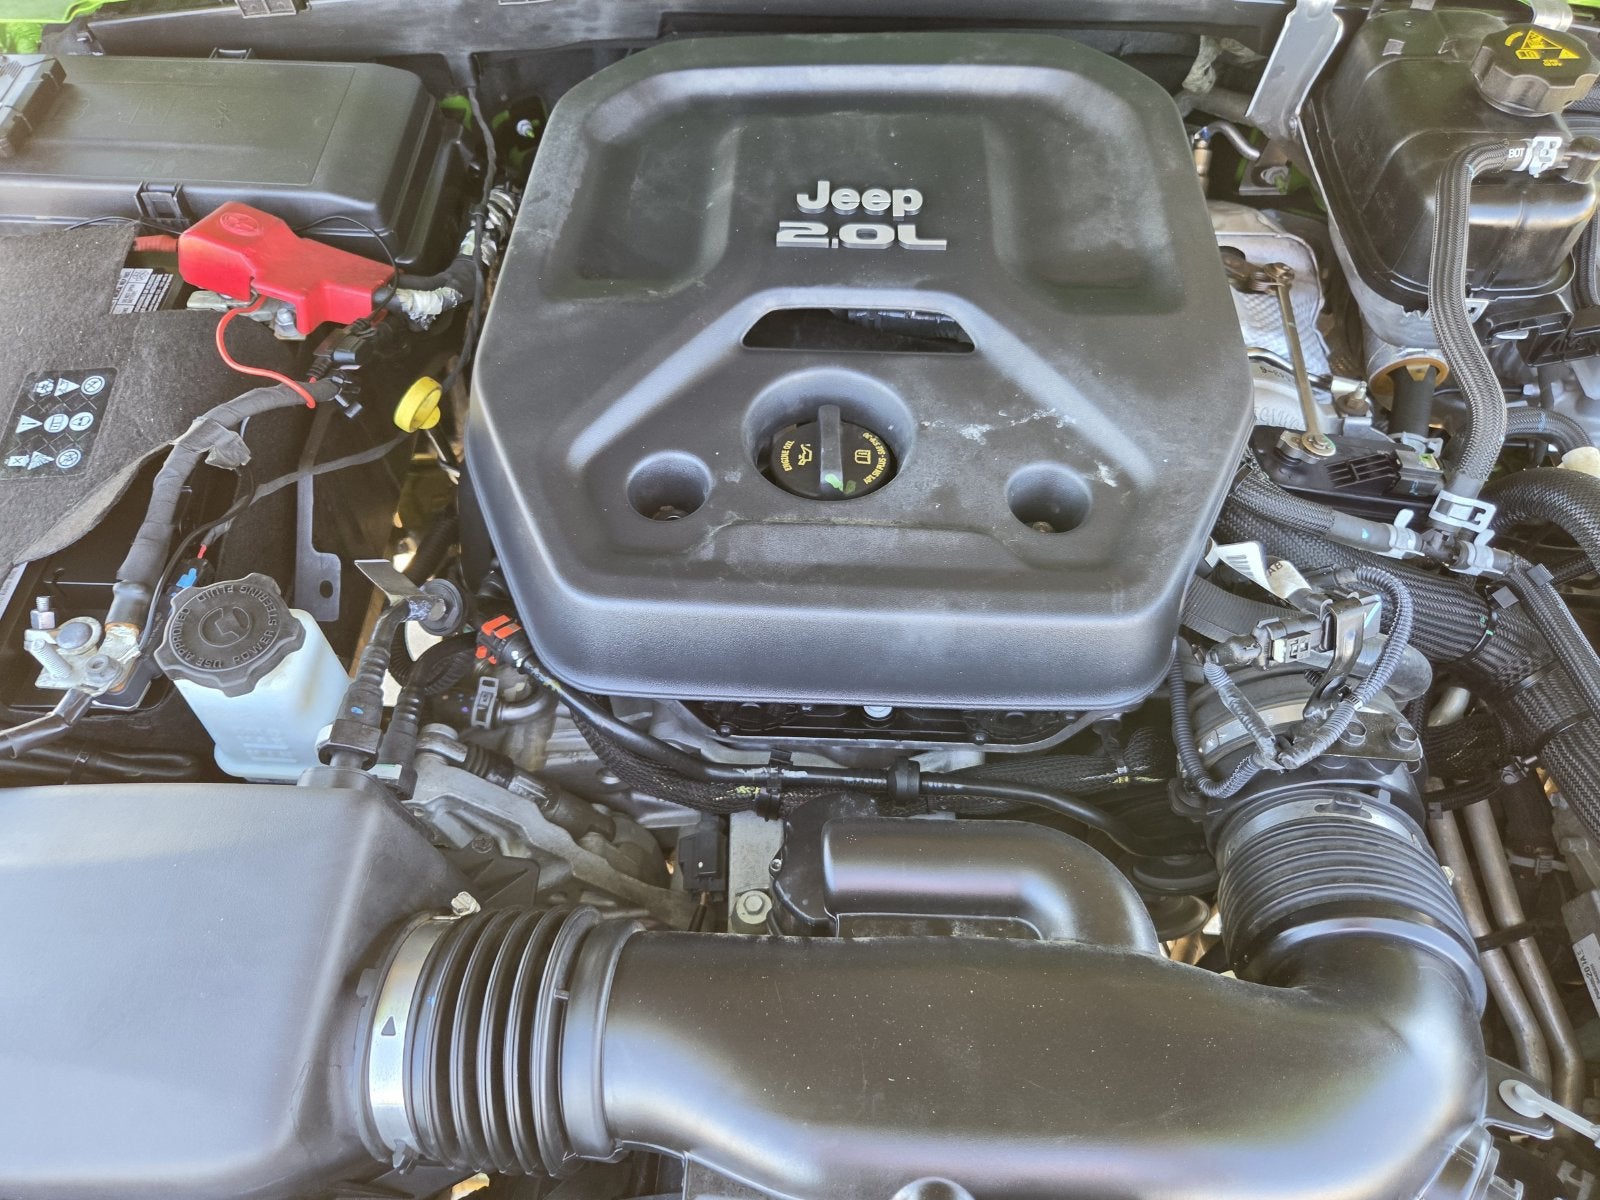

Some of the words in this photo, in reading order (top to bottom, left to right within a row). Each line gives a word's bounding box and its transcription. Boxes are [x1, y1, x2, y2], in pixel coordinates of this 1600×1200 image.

[1508, 147, 1526, 159] BOT
[796, 180, 923, 221] Jeep
[776, 221, 947, 250] 2.0L
[782, 440, 795, 450] OIL
[780, 449, 793, 472] ENGINE
[875, 457, 887, 470] PLUS
[195, 584, 235, 602] FLUID
[239, 585, 278, 627] STEERING
[172, 607, 195, 661] APPROVED
[232, 629, 275, 665] POWER
[195, 657, 223, 668] USE
